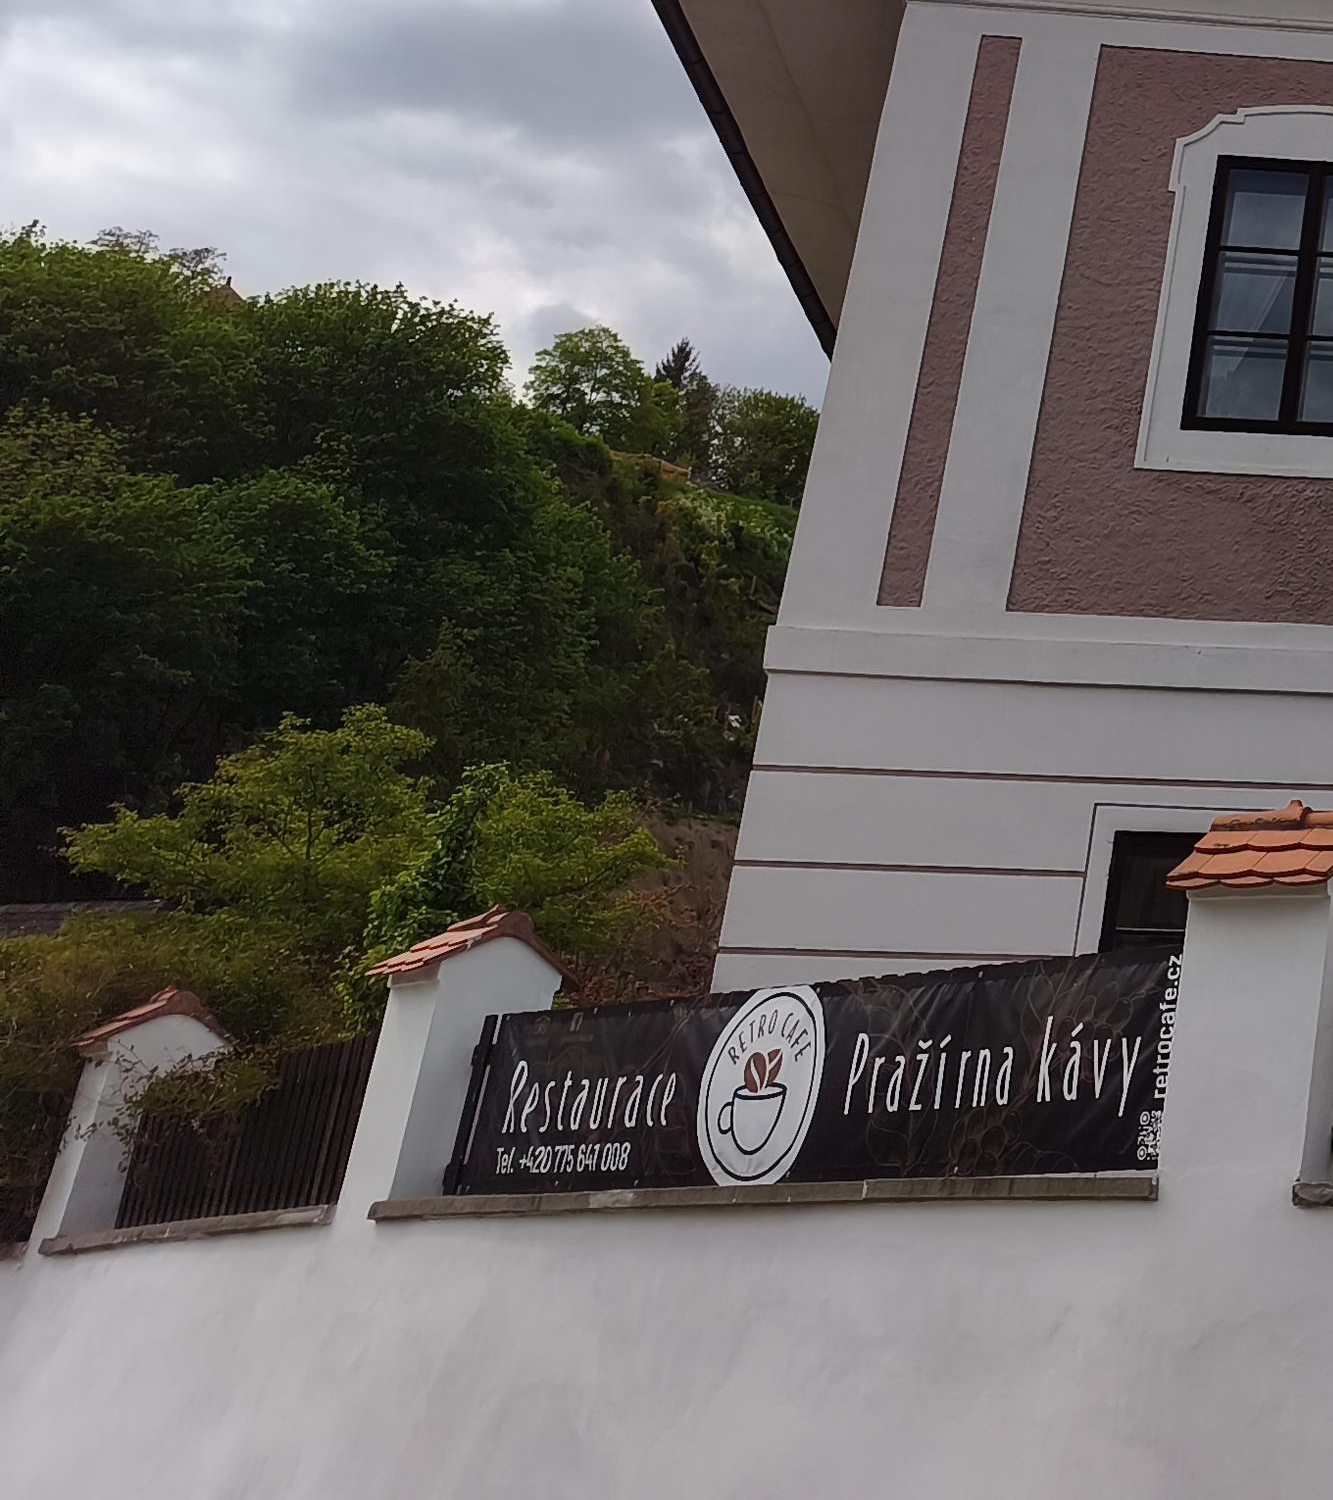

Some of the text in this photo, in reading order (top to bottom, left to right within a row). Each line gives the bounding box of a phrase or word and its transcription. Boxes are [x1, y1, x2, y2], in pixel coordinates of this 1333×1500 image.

[728, 1009, 811, 1065] RETRO CAFE
[1153, 954, 1182, 1099] retrocafe.cz
[502, 1060, 676, 1133] Restaurace
[844, 1032, 1013, 1115] Pražírna
[496, 1141, 631, 1174] Tel. +420 775 641 008
